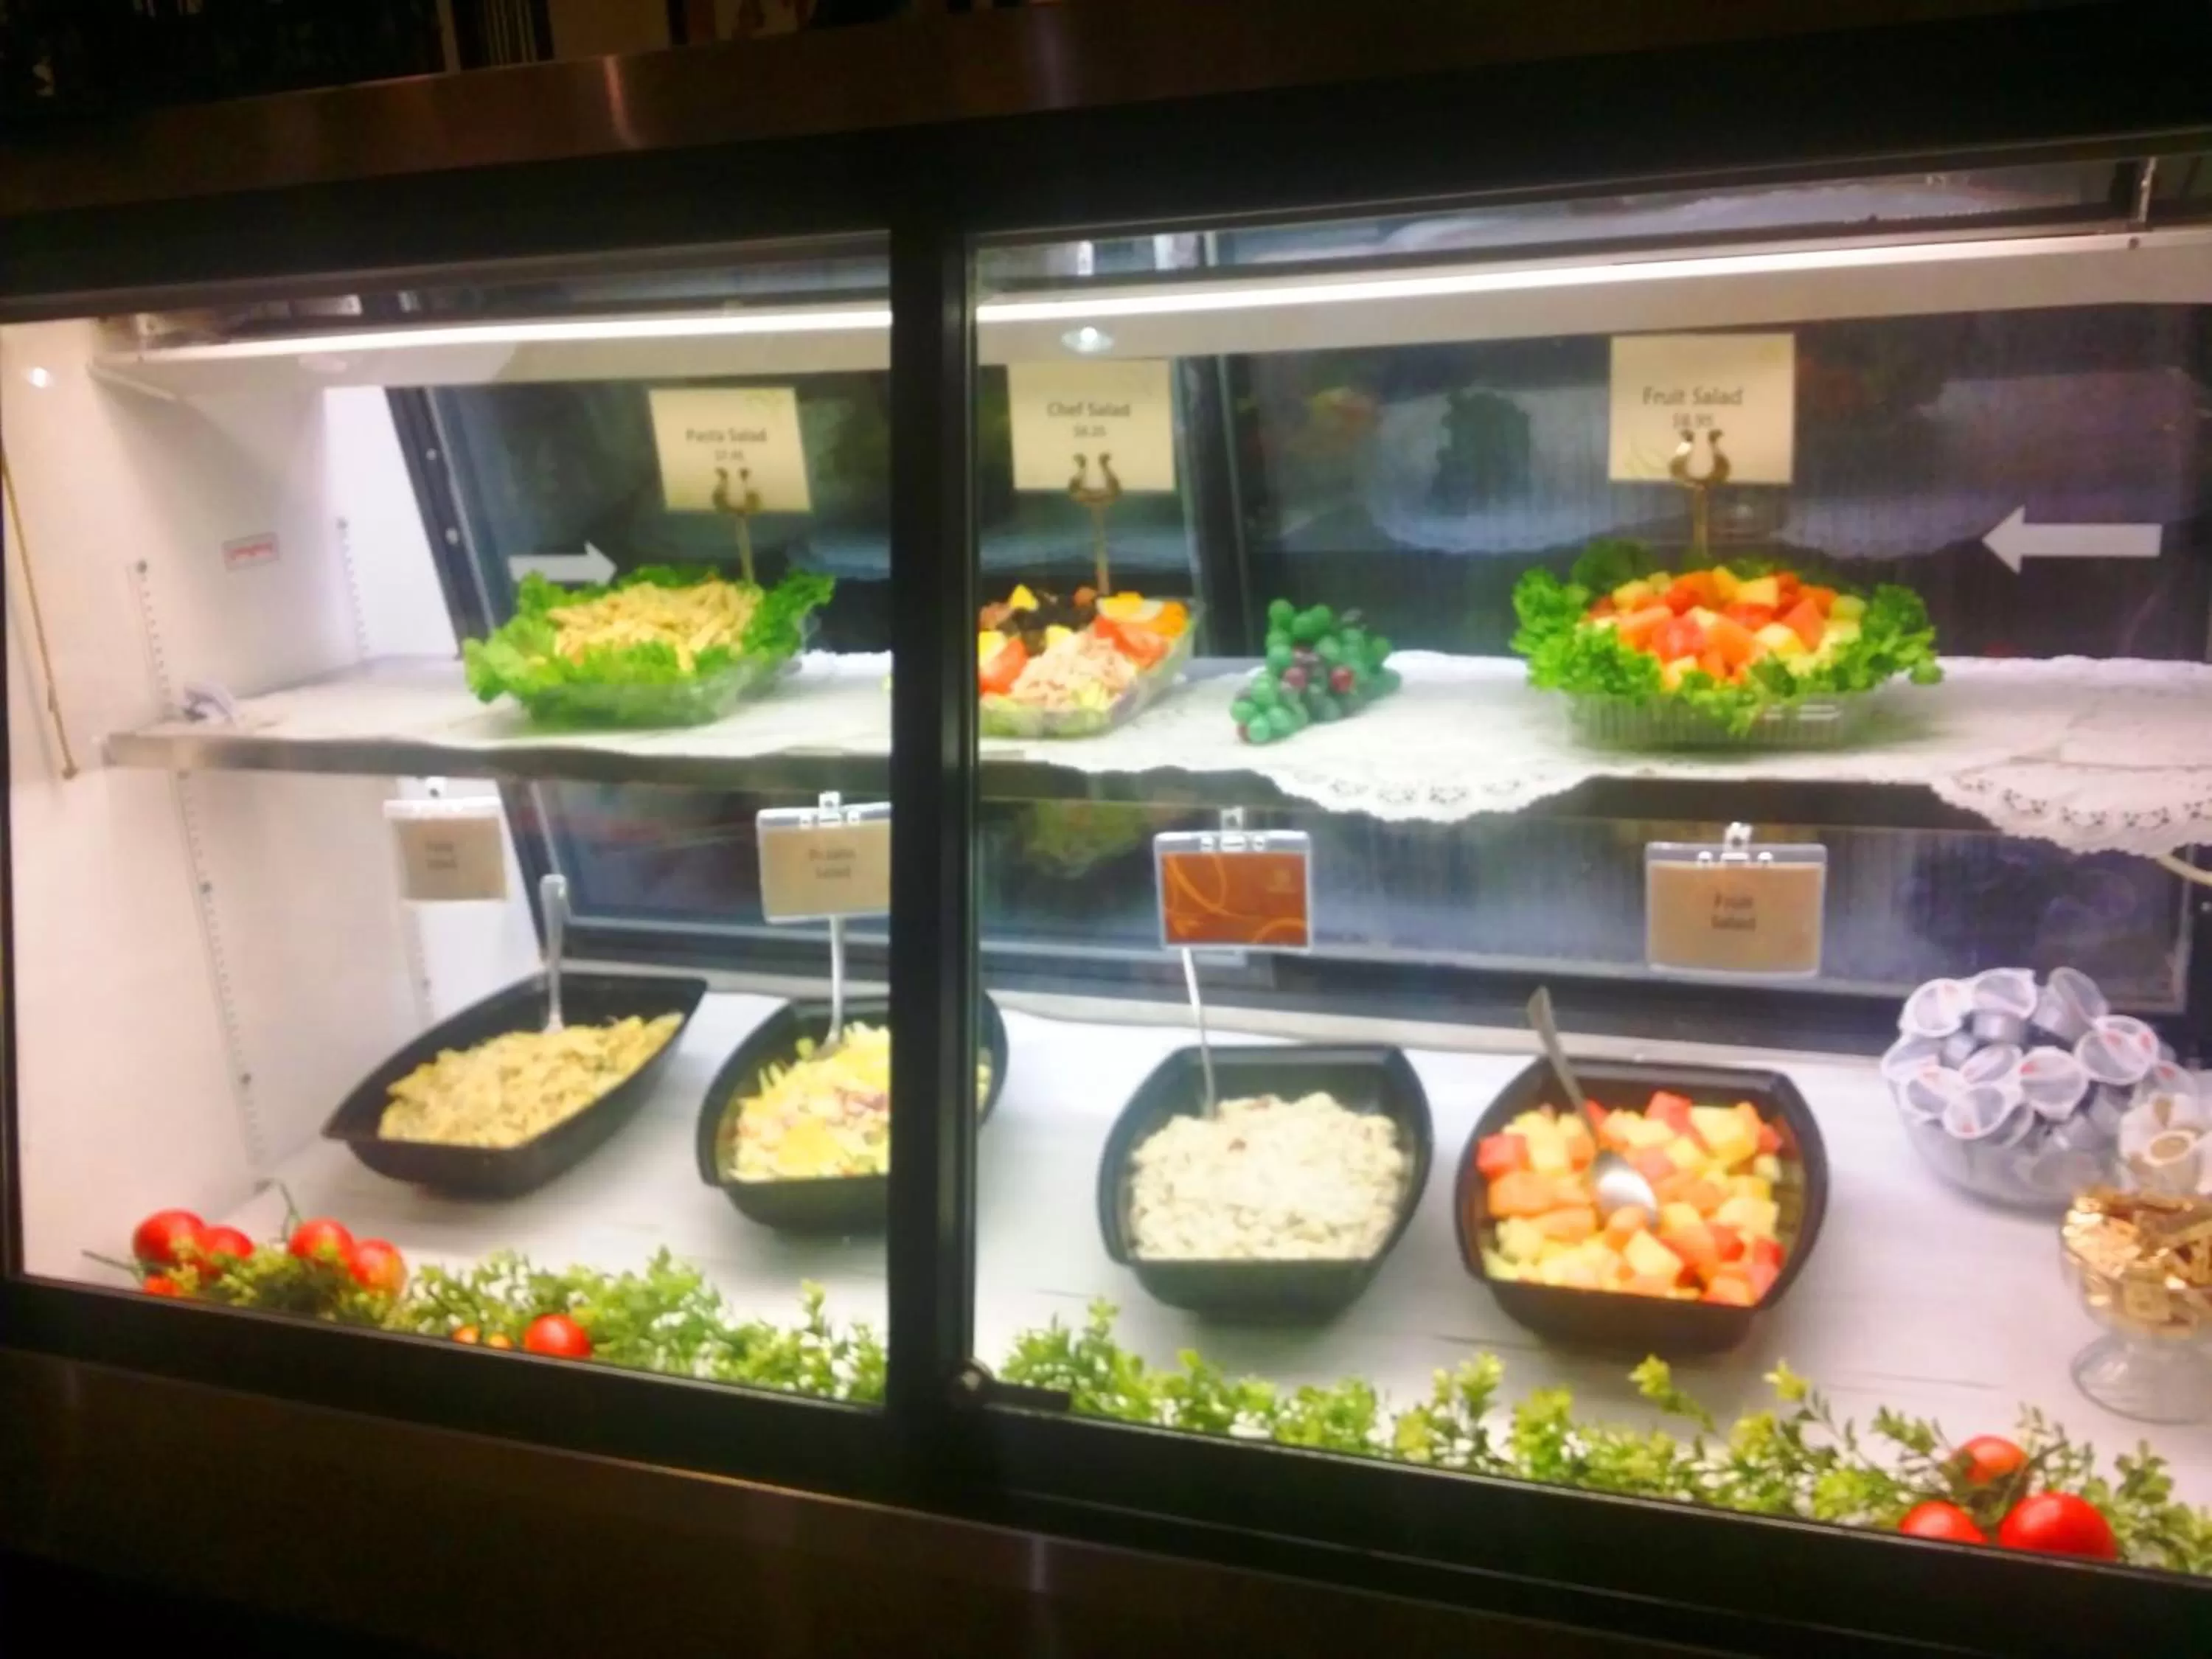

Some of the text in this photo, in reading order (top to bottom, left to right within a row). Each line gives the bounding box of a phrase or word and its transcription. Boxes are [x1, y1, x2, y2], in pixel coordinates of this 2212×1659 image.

[1642, 384, 1744, 405] Fruit Salad
[1046, 401, 1131, 417] Chef Salad
[685, 427, 768, 442] Pasta Salad
